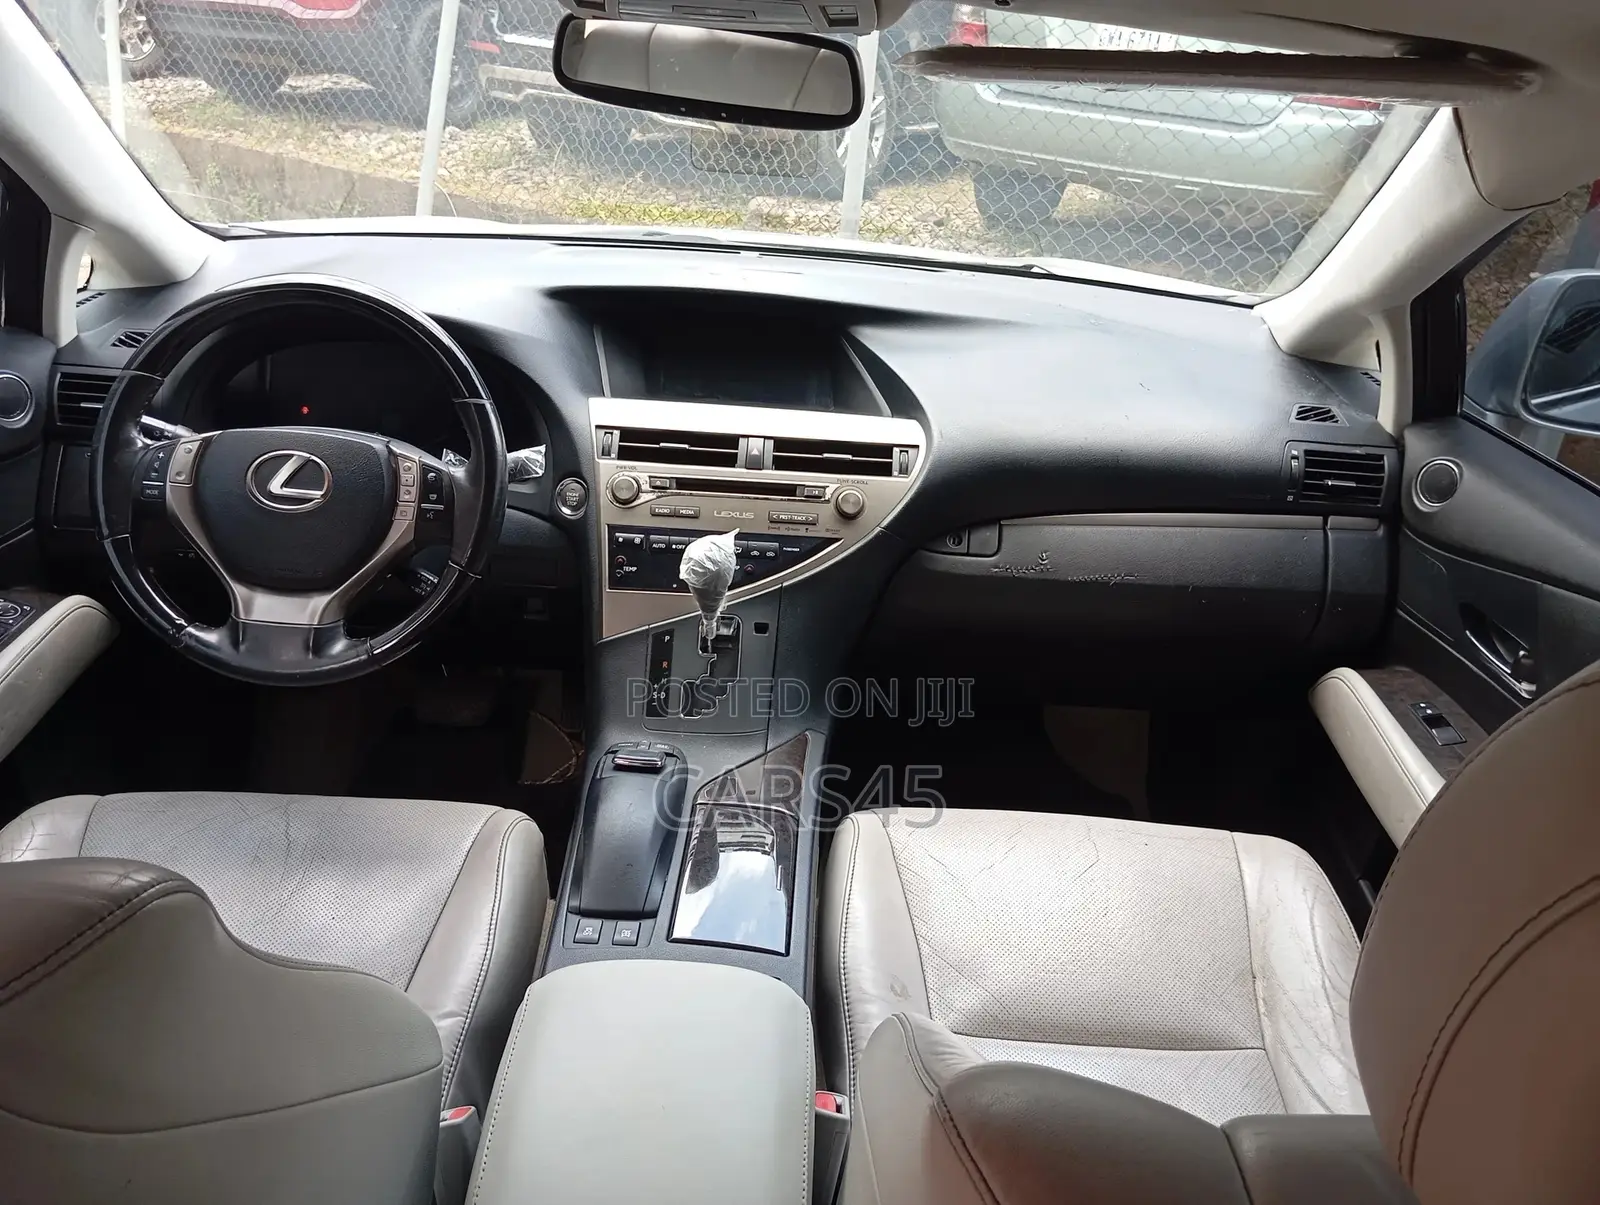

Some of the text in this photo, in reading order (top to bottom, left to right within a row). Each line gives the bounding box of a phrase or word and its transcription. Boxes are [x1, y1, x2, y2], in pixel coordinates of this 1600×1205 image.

[679, 508, 695, 516] MEDIA
[713, 509, 755, 519] LEXUS
[664, 635, 671, 643] P
[662, 661, 668, 669] R
